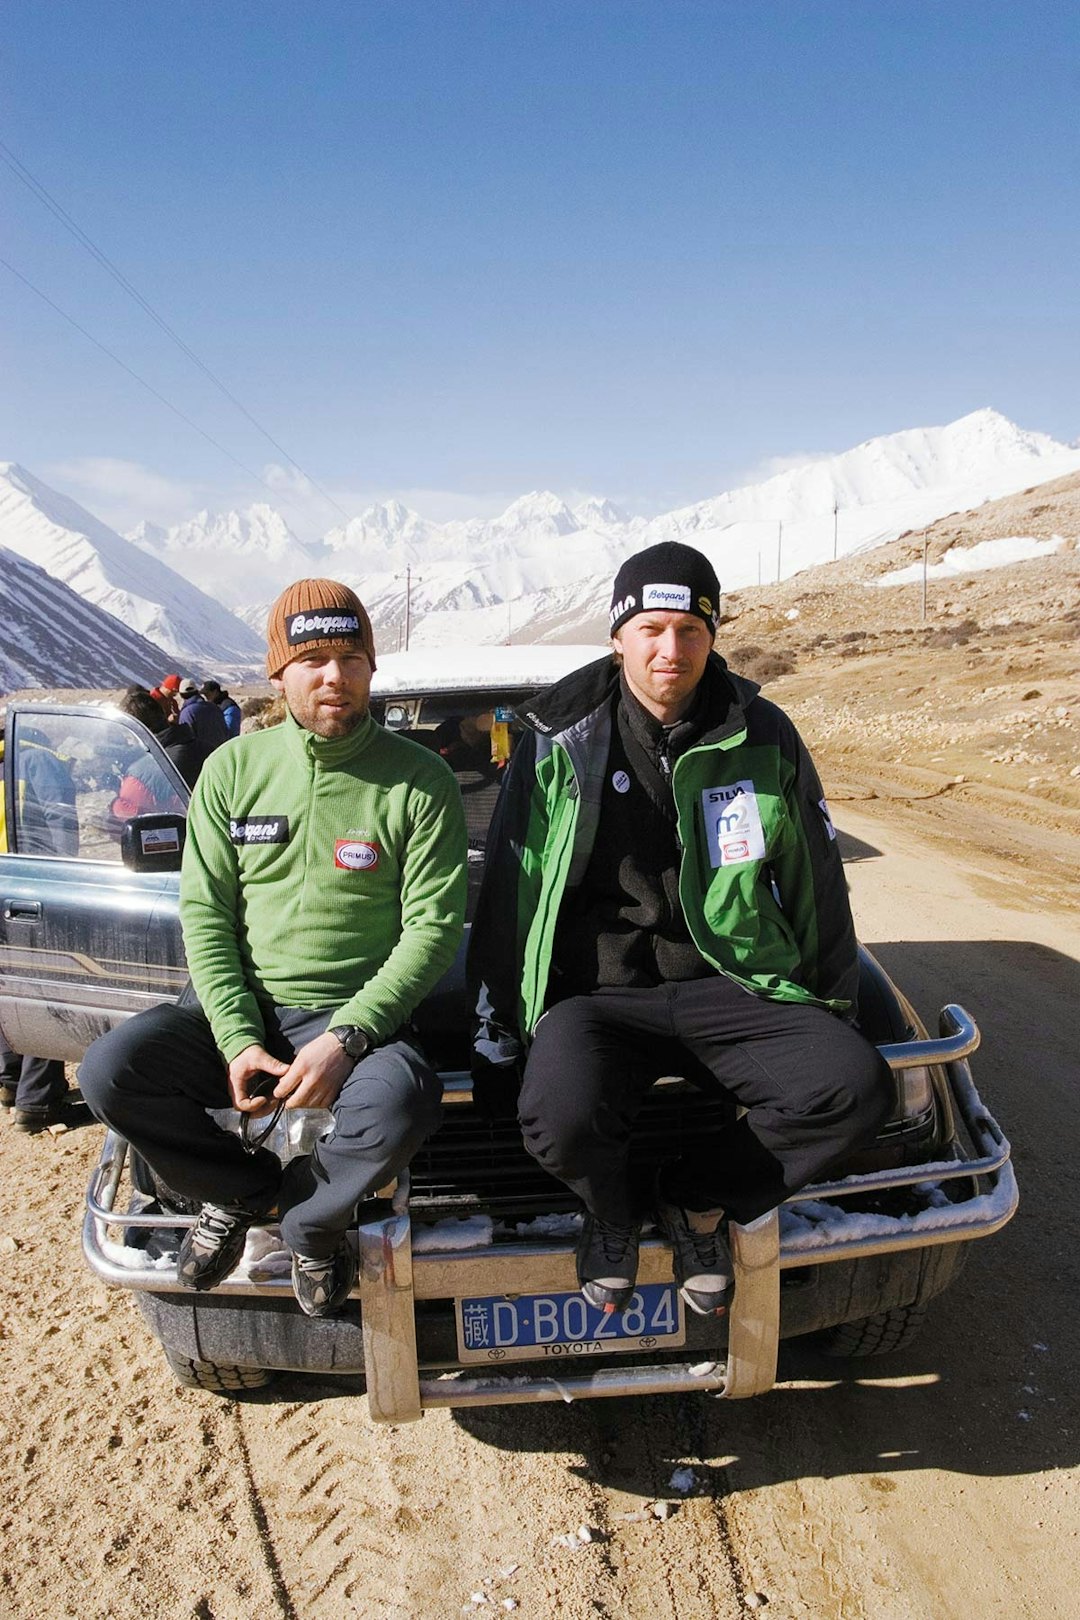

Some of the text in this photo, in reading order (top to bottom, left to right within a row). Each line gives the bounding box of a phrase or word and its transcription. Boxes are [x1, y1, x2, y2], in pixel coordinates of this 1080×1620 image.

[648, 590, 686, 602] Bergans
[290, 614, 359, 637] Bergans
[708, 786, 746, 803] SILVA
[342, 848, 373, 861] PRIMUS
[541, 1342, 603, 1356] TOYOTA
